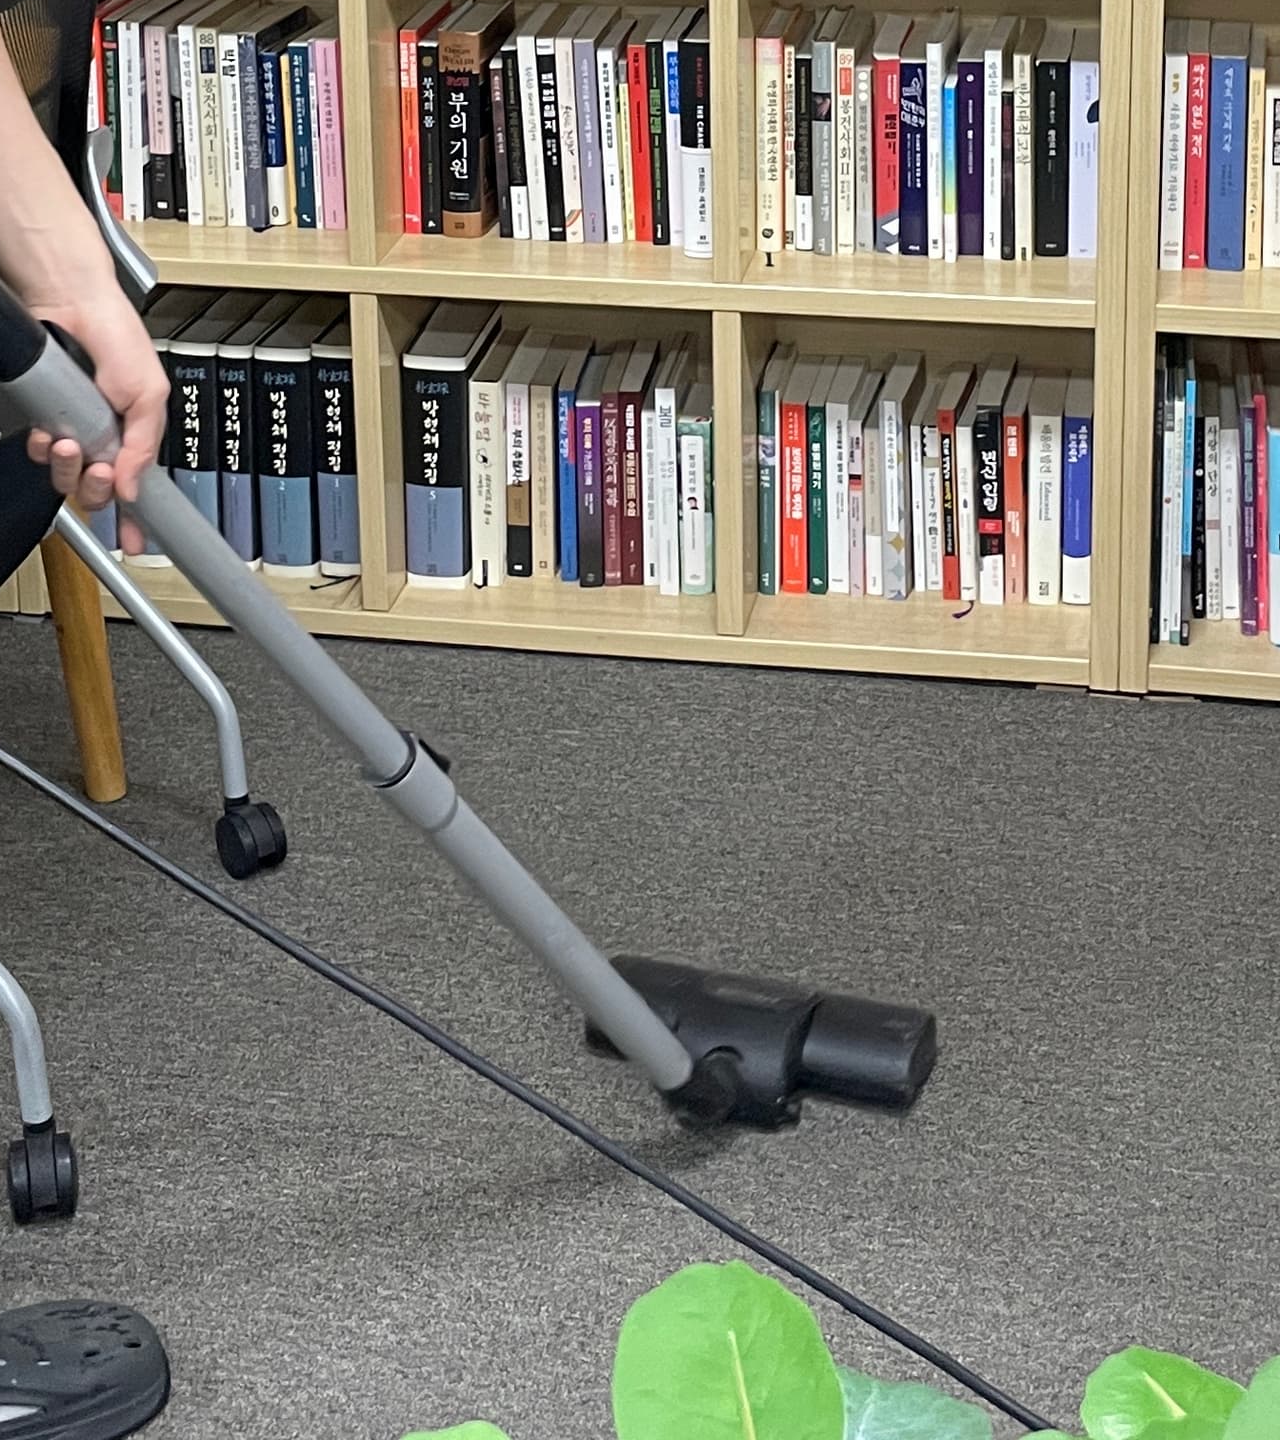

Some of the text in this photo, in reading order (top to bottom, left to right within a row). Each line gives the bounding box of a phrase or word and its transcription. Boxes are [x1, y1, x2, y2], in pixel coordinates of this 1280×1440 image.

[200, 34, 215, 45] 88
[222, 50, 236, 77] 박탈
[839, 54, 853, 65] 89
[203, 79, 217, 138] 봉건사회
[540, 74, 557, 132] 백범일지
[1190, 64, 1205, 158] 싸가지 없는 정치
[448, 92, 469, 180] 부의 기원
[839, 99, 851, 162] 봉건사회
[767, 136, 777, 182] 한국현대사
[182, 385, 200, 435] 박현채
[224, 387, 240, 436] 박현채
[268, 391, 287, 441] 박현채
[325, 388, 342, 438] 박현채
[421, 399, 439, 450] 박현채
[185, 438, 200, 470] 전집
[226, 439, 240, 471] 전집
[271, 444, 287, 476] 전집
[327, 440, 342, 473] 전집
[423, 453, 439, 485] 전집
[512, 429, 523, 487] 부의 추월차선
[791, 446, 802, 519] 보이지 않는 여자들
[981, 450, 998, 512] 변신 인형
[1043, 481, 1052, 521] Educated
